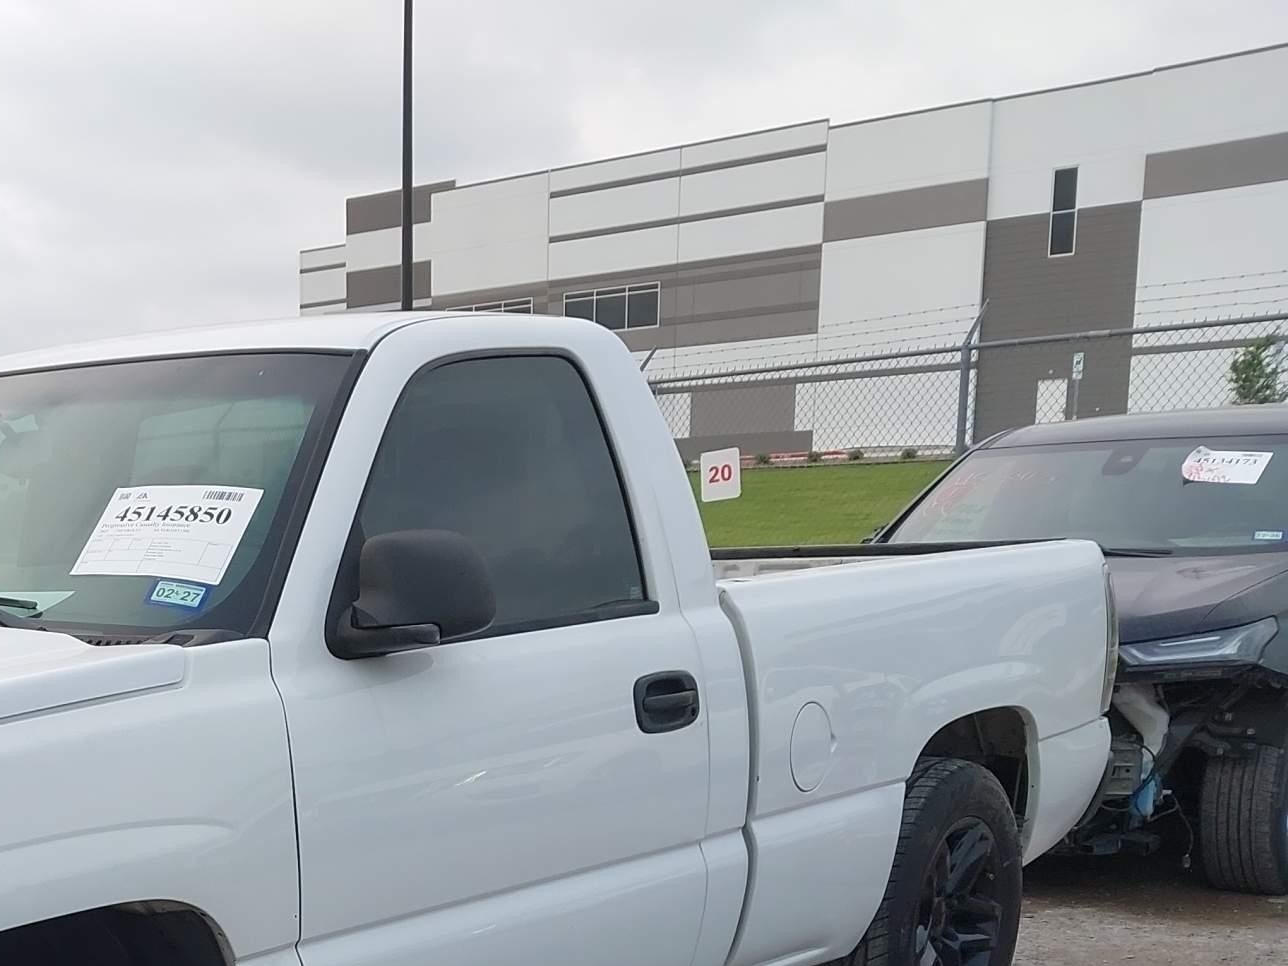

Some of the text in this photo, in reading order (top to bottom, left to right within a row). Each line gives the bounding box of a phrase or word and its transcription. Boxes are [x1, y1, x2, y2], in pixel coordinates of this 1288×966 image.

[709, 464, 732, 483] 20
[115, 505, 232, 525] 45145850
[156, 587, 201, 602] 02 27
